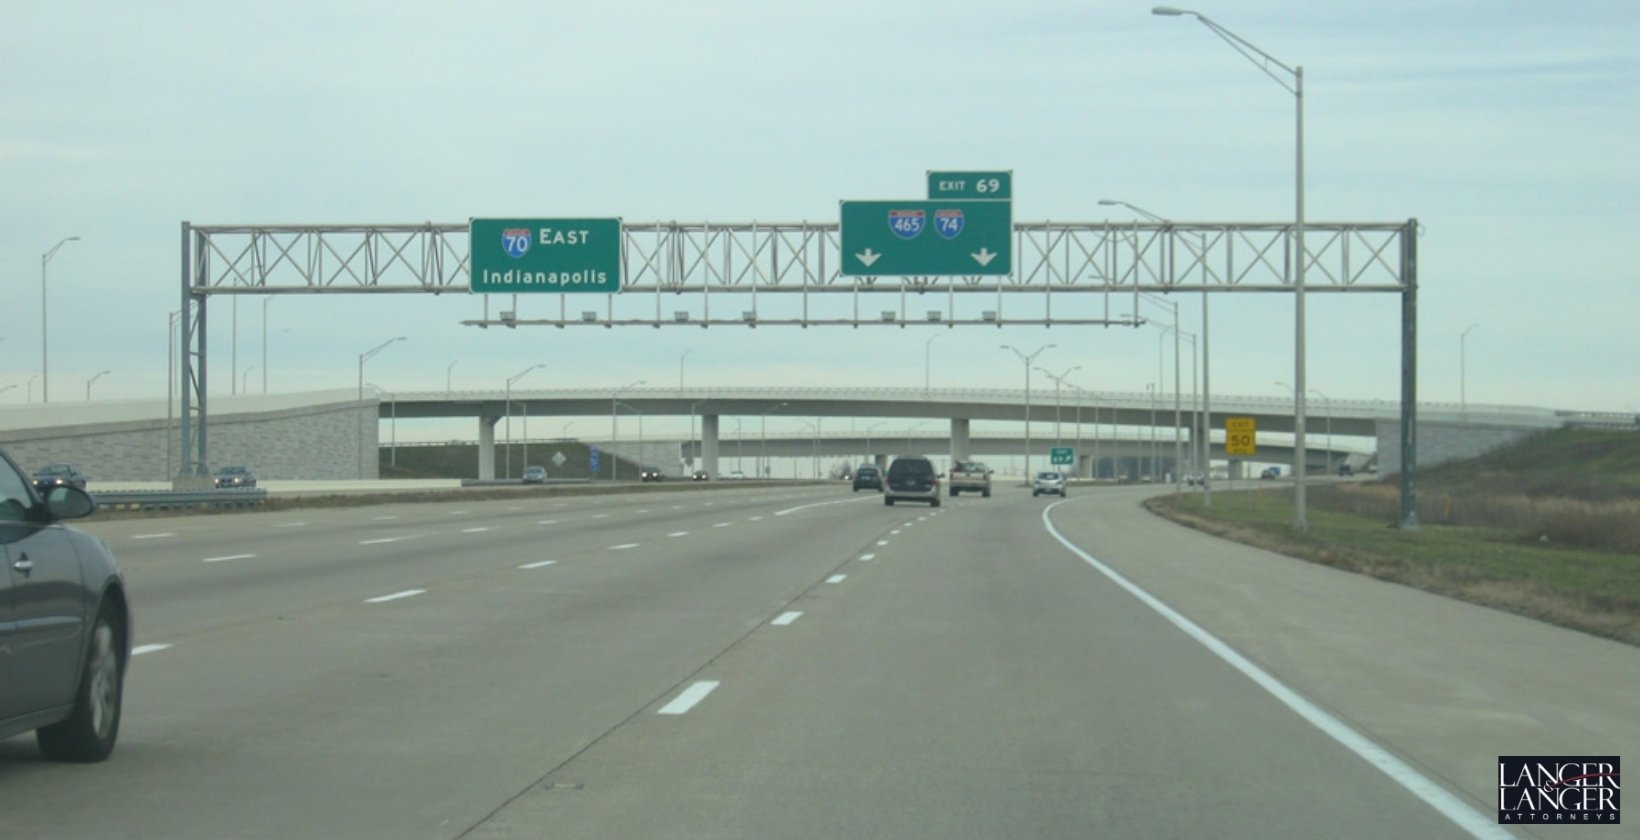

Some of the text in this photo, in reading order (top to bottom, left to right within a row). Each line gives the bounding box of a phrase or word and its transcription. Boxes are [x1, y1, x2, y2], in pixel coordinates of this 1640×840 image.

[939, 179, 1000, 193] EXIT 69
[894, 218, 958, 232] 465 74
[505, 236, 528, 252] 70
[539, 228, 589, 245] EAST
[483, 269, 607, 286] Indianapolis
[1231, 435, 1250, 447] 50
